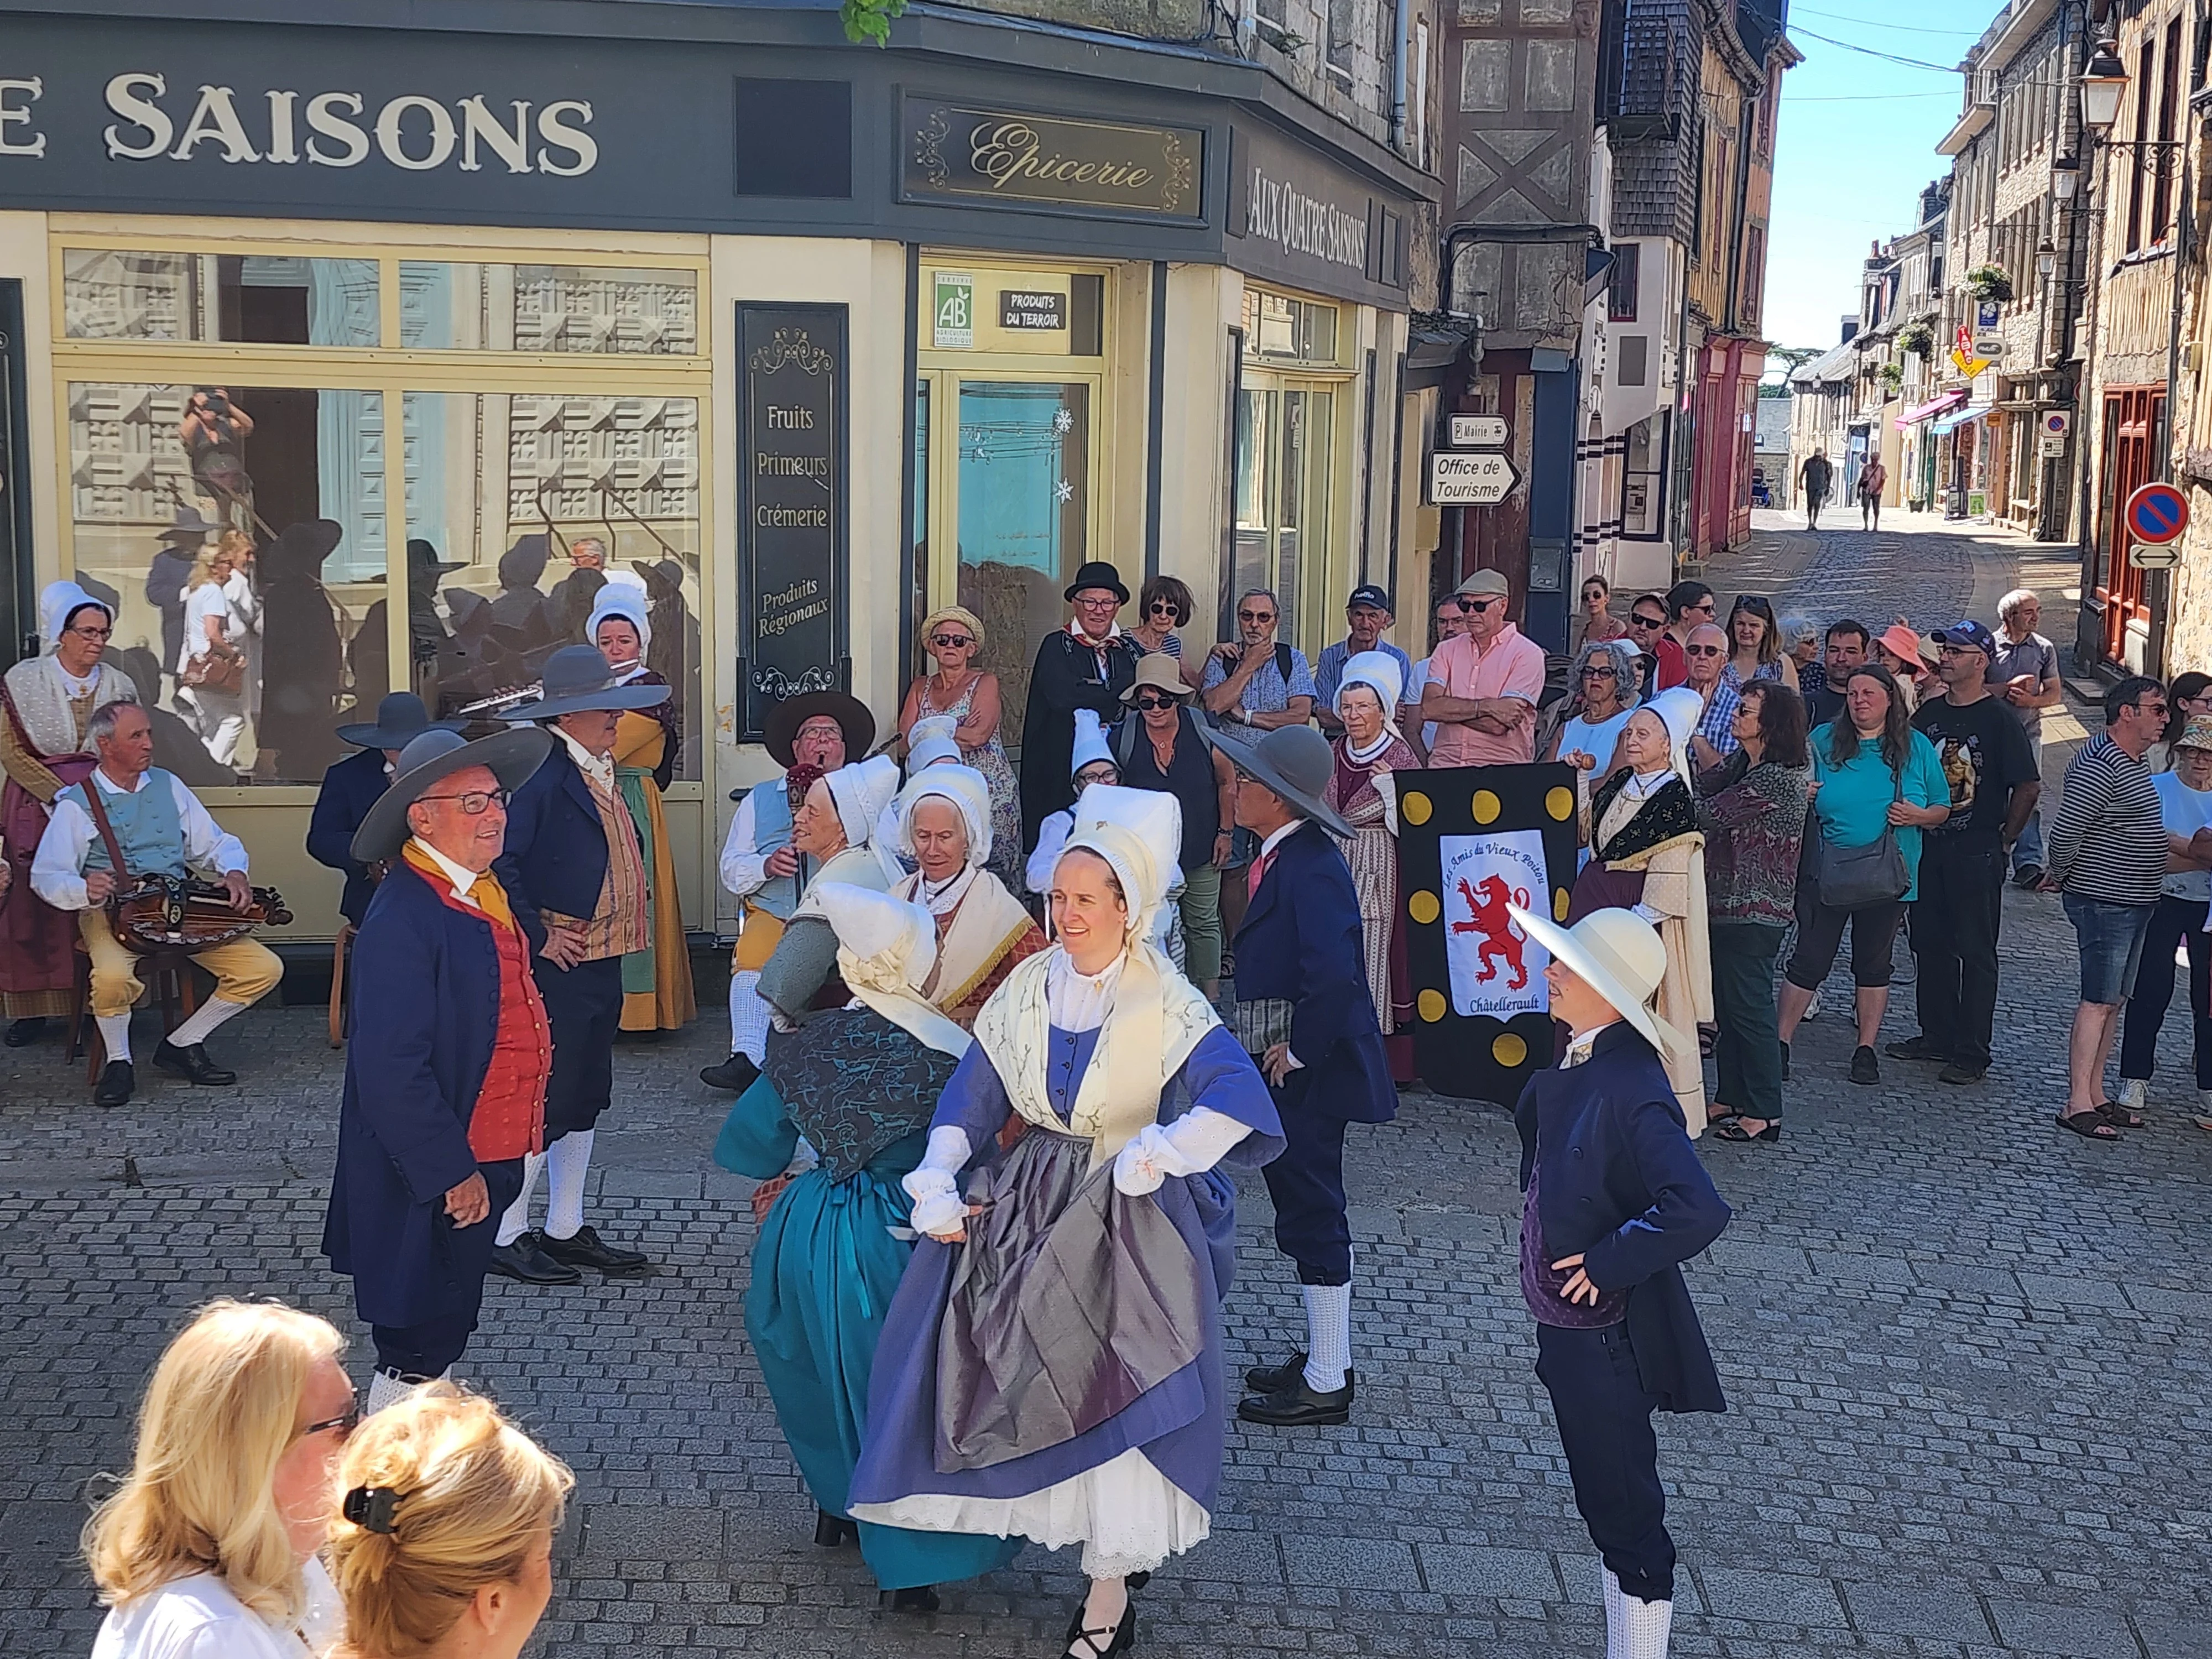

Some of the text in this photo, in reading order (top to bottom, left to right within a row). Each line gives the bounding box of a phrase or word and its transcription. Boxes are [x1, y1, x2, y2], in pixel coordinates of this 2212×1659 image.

[104, 72, 599, 176] SAISONS
[970, 122, 1154, 188] Epicerie
[1249, 167, 1365, 270] AUX QUATRE SAISONS
[939, 297, 967, 327] AB
[1011, 294, 1055, 309] PRODUITS
[1006, 312, 1060, 328] DU TERROIR
[1959, 327, 1972, 364] TABAC
[767, 405, 814, 429] Fruits
[1455, 425, 1488, 437] P Mairie
[758, 451, 828, 476] Primeurs
[1438, 459, 1500, 475] Office de
[1437, 482, 1500, 497] Tourisme
[757, 503, 827, 527] Crémerie
[763, 579, 817, 613] Produits
[758, 598, 828, 638] Régionaux
[1443, 842, 1546, 890] Les Amis du Vieux Poitou
[1470, 994, 1539, 1013] Châtellerault
